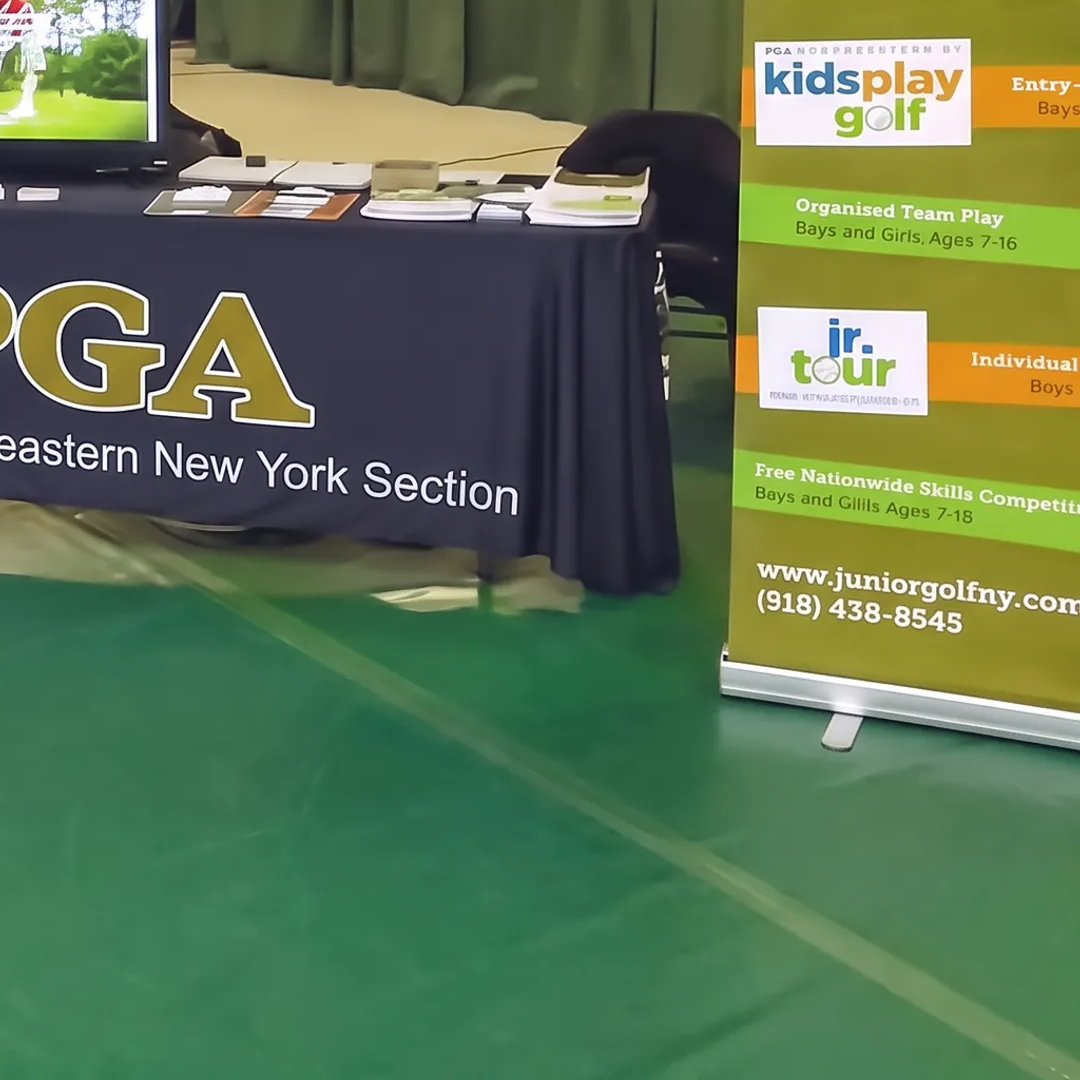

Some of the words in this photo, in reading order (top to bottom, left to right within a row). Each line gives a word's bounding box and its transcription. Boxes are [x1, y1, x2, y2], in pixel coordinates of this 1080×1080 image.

[764, 61, 963, 102] kidsplay
[834, 98, 927, 138] golf
[1038, 101, 1080, 119] Bays
[795, 197, 895, 218] Organised
[901, 204, 954, 223] Team
[960, 208, 1004, 228] Play
[796, 221, 836, 240] Bays
[843, 226, 875, 241] and
[929, 231, 974, 249] Ages
[980, 234, 1018, 251] 7-16
[828, 318, 874, 358] jr.
[790, 350, 896, 387] tour
[971, 352, 1078, 372] Individual
[1030, 379, 1074, 396] Boys
[155, 439, 244, 484] New
[256, 450, 349, 495] York
[363, 461, 519, 516] Section
[754, 463, 795, 480] Free
[800, 468, 915, 495] Nationwide
[919, 481, 974, 502] Skills
[755, 486, 795, 506] Bays
[801, 493, 834, 509] and
[885, 502, 930, 521] Ages
[937, 507, 974, 525] 7-18
[757, 561, 1080, 615] www.juniorgolfny.com
[757, 589, 821, 620] (918)
[828, 598, 964, 634] 438-8545
